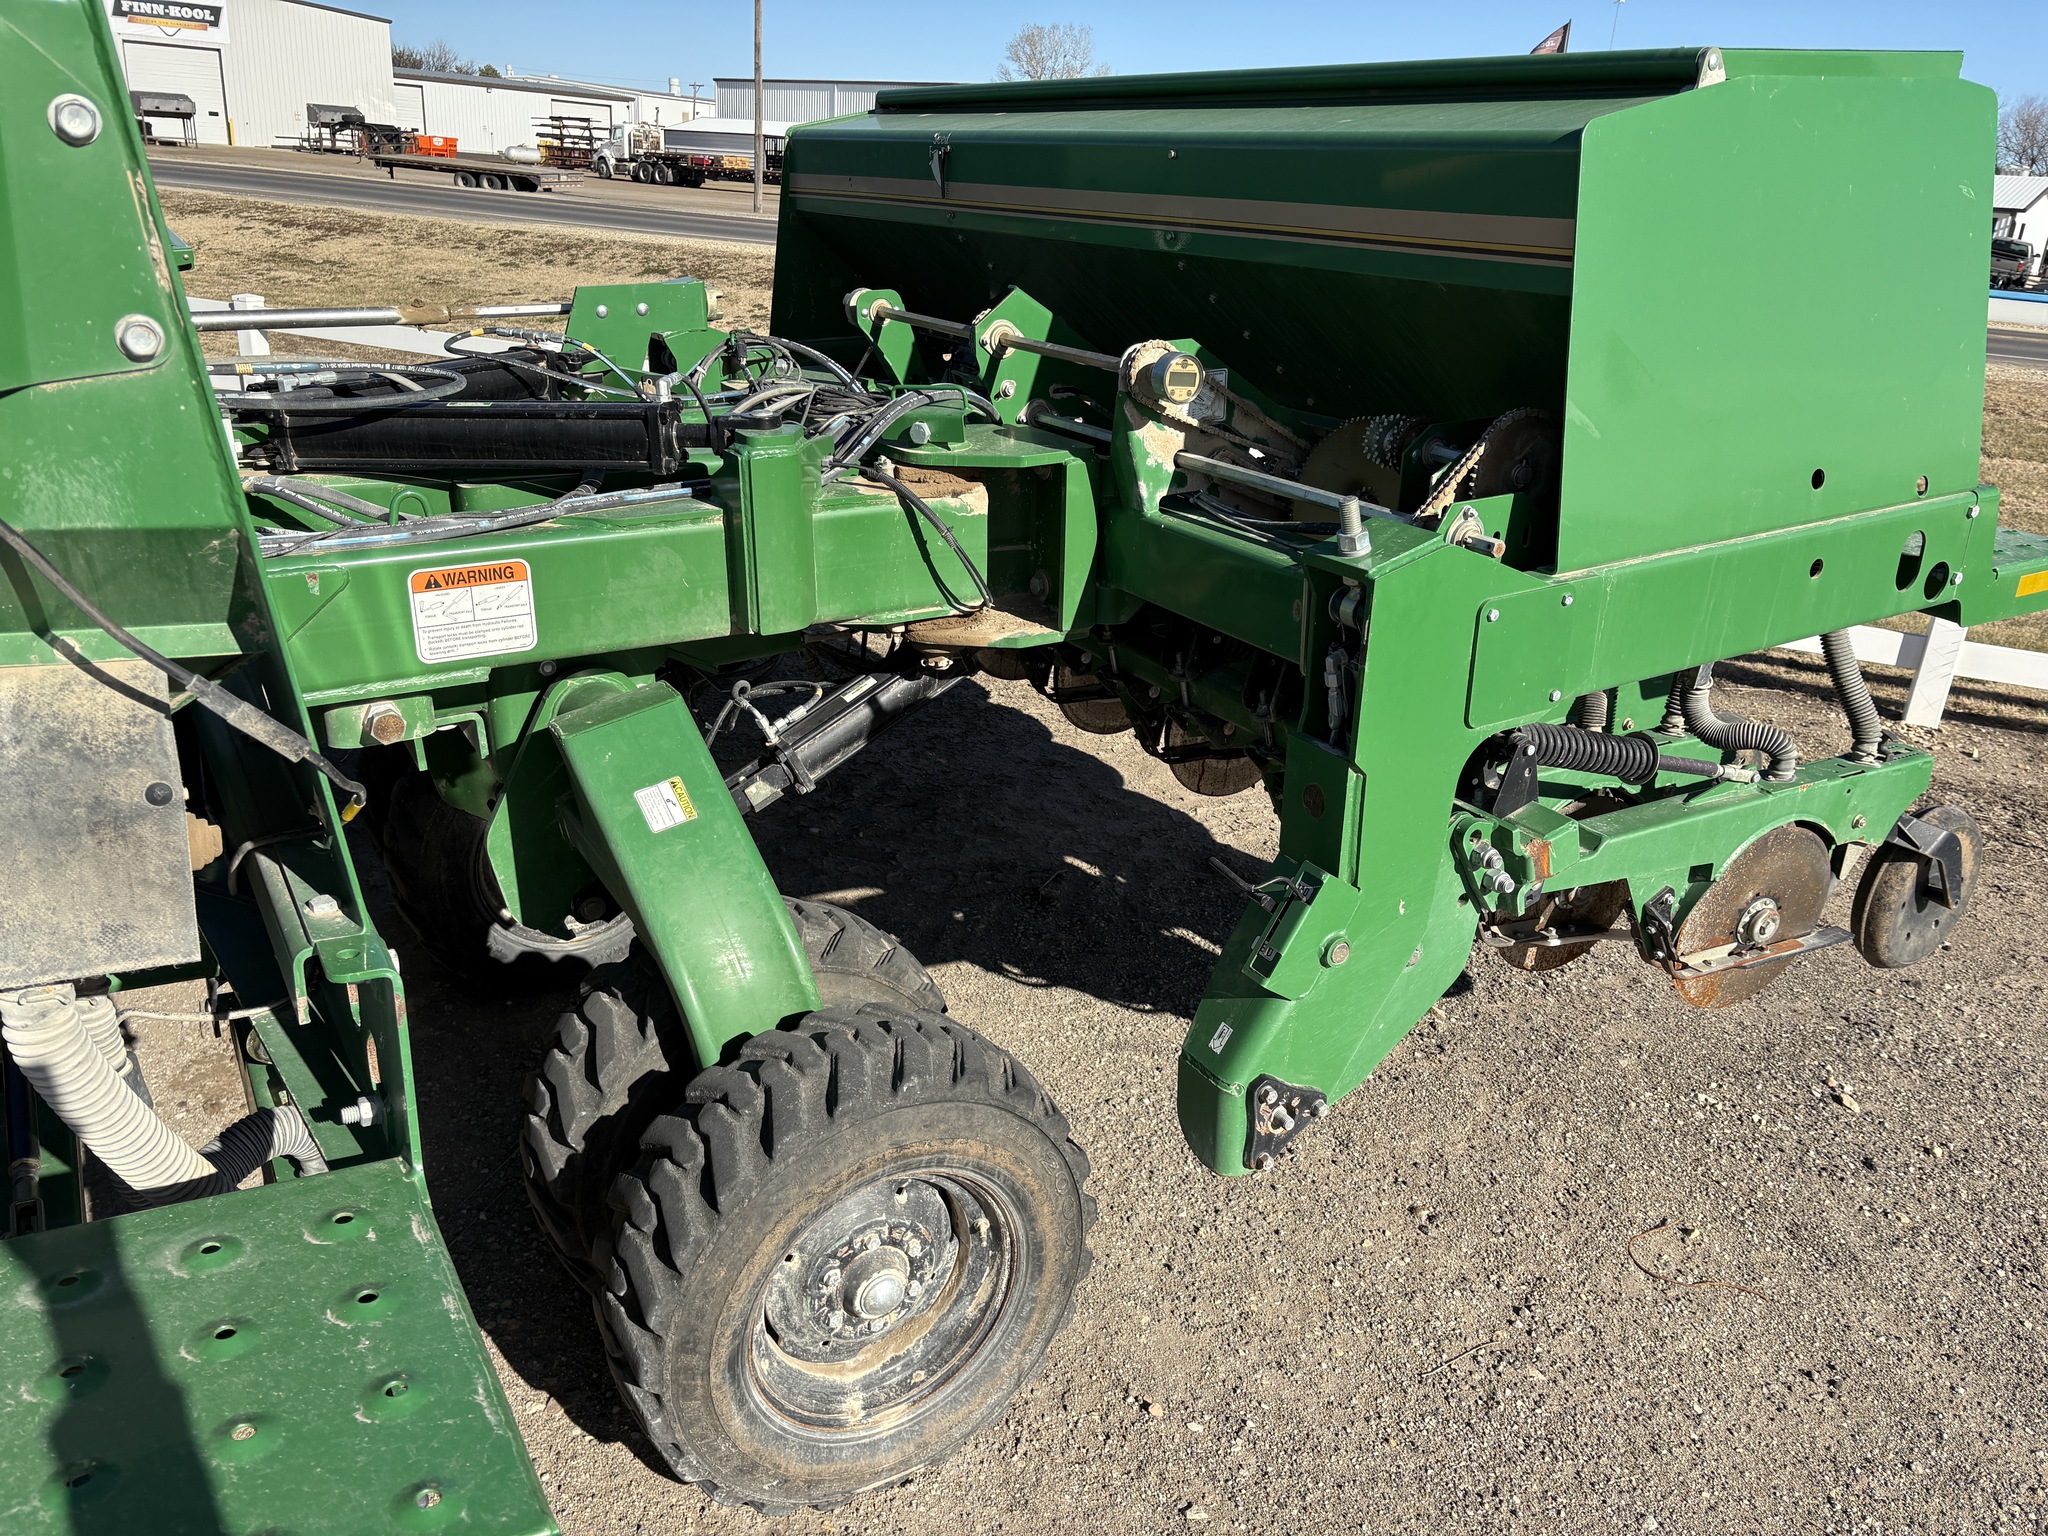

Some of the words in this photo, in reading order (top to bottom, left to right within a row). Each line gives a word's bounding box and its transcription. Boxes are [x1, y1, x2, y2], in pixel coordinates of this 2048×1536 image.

[121, 1, 215, 21] FINN-KOOL
[442, 566, 515, 586] WARNING
[674, 786, 694, 818] CAUTION
